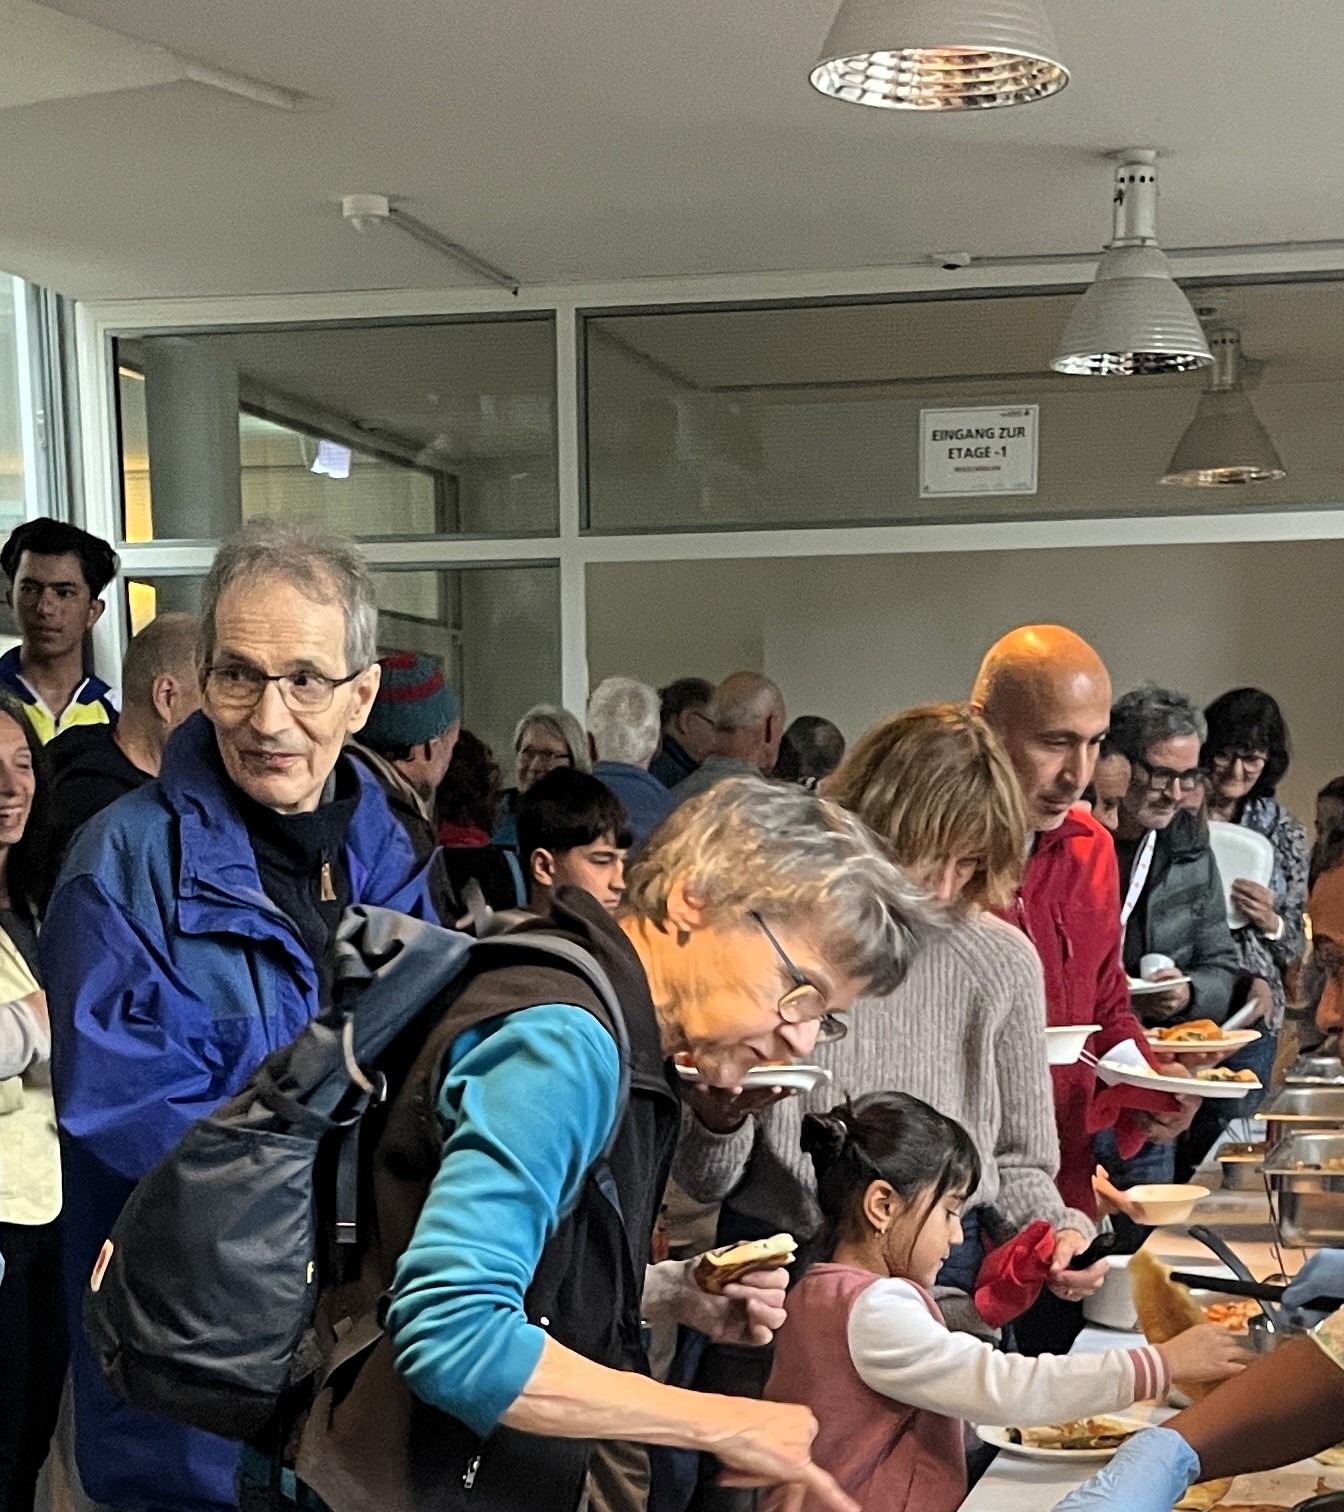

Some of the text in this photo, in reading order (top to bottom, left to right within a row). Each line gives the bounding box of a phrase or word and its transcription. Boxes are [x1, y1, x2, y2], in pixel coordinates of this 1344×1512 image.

[931, 426, 1026, 442] EINGANG ZUR
[948, 445, 1007, 460] ETAGE -1
